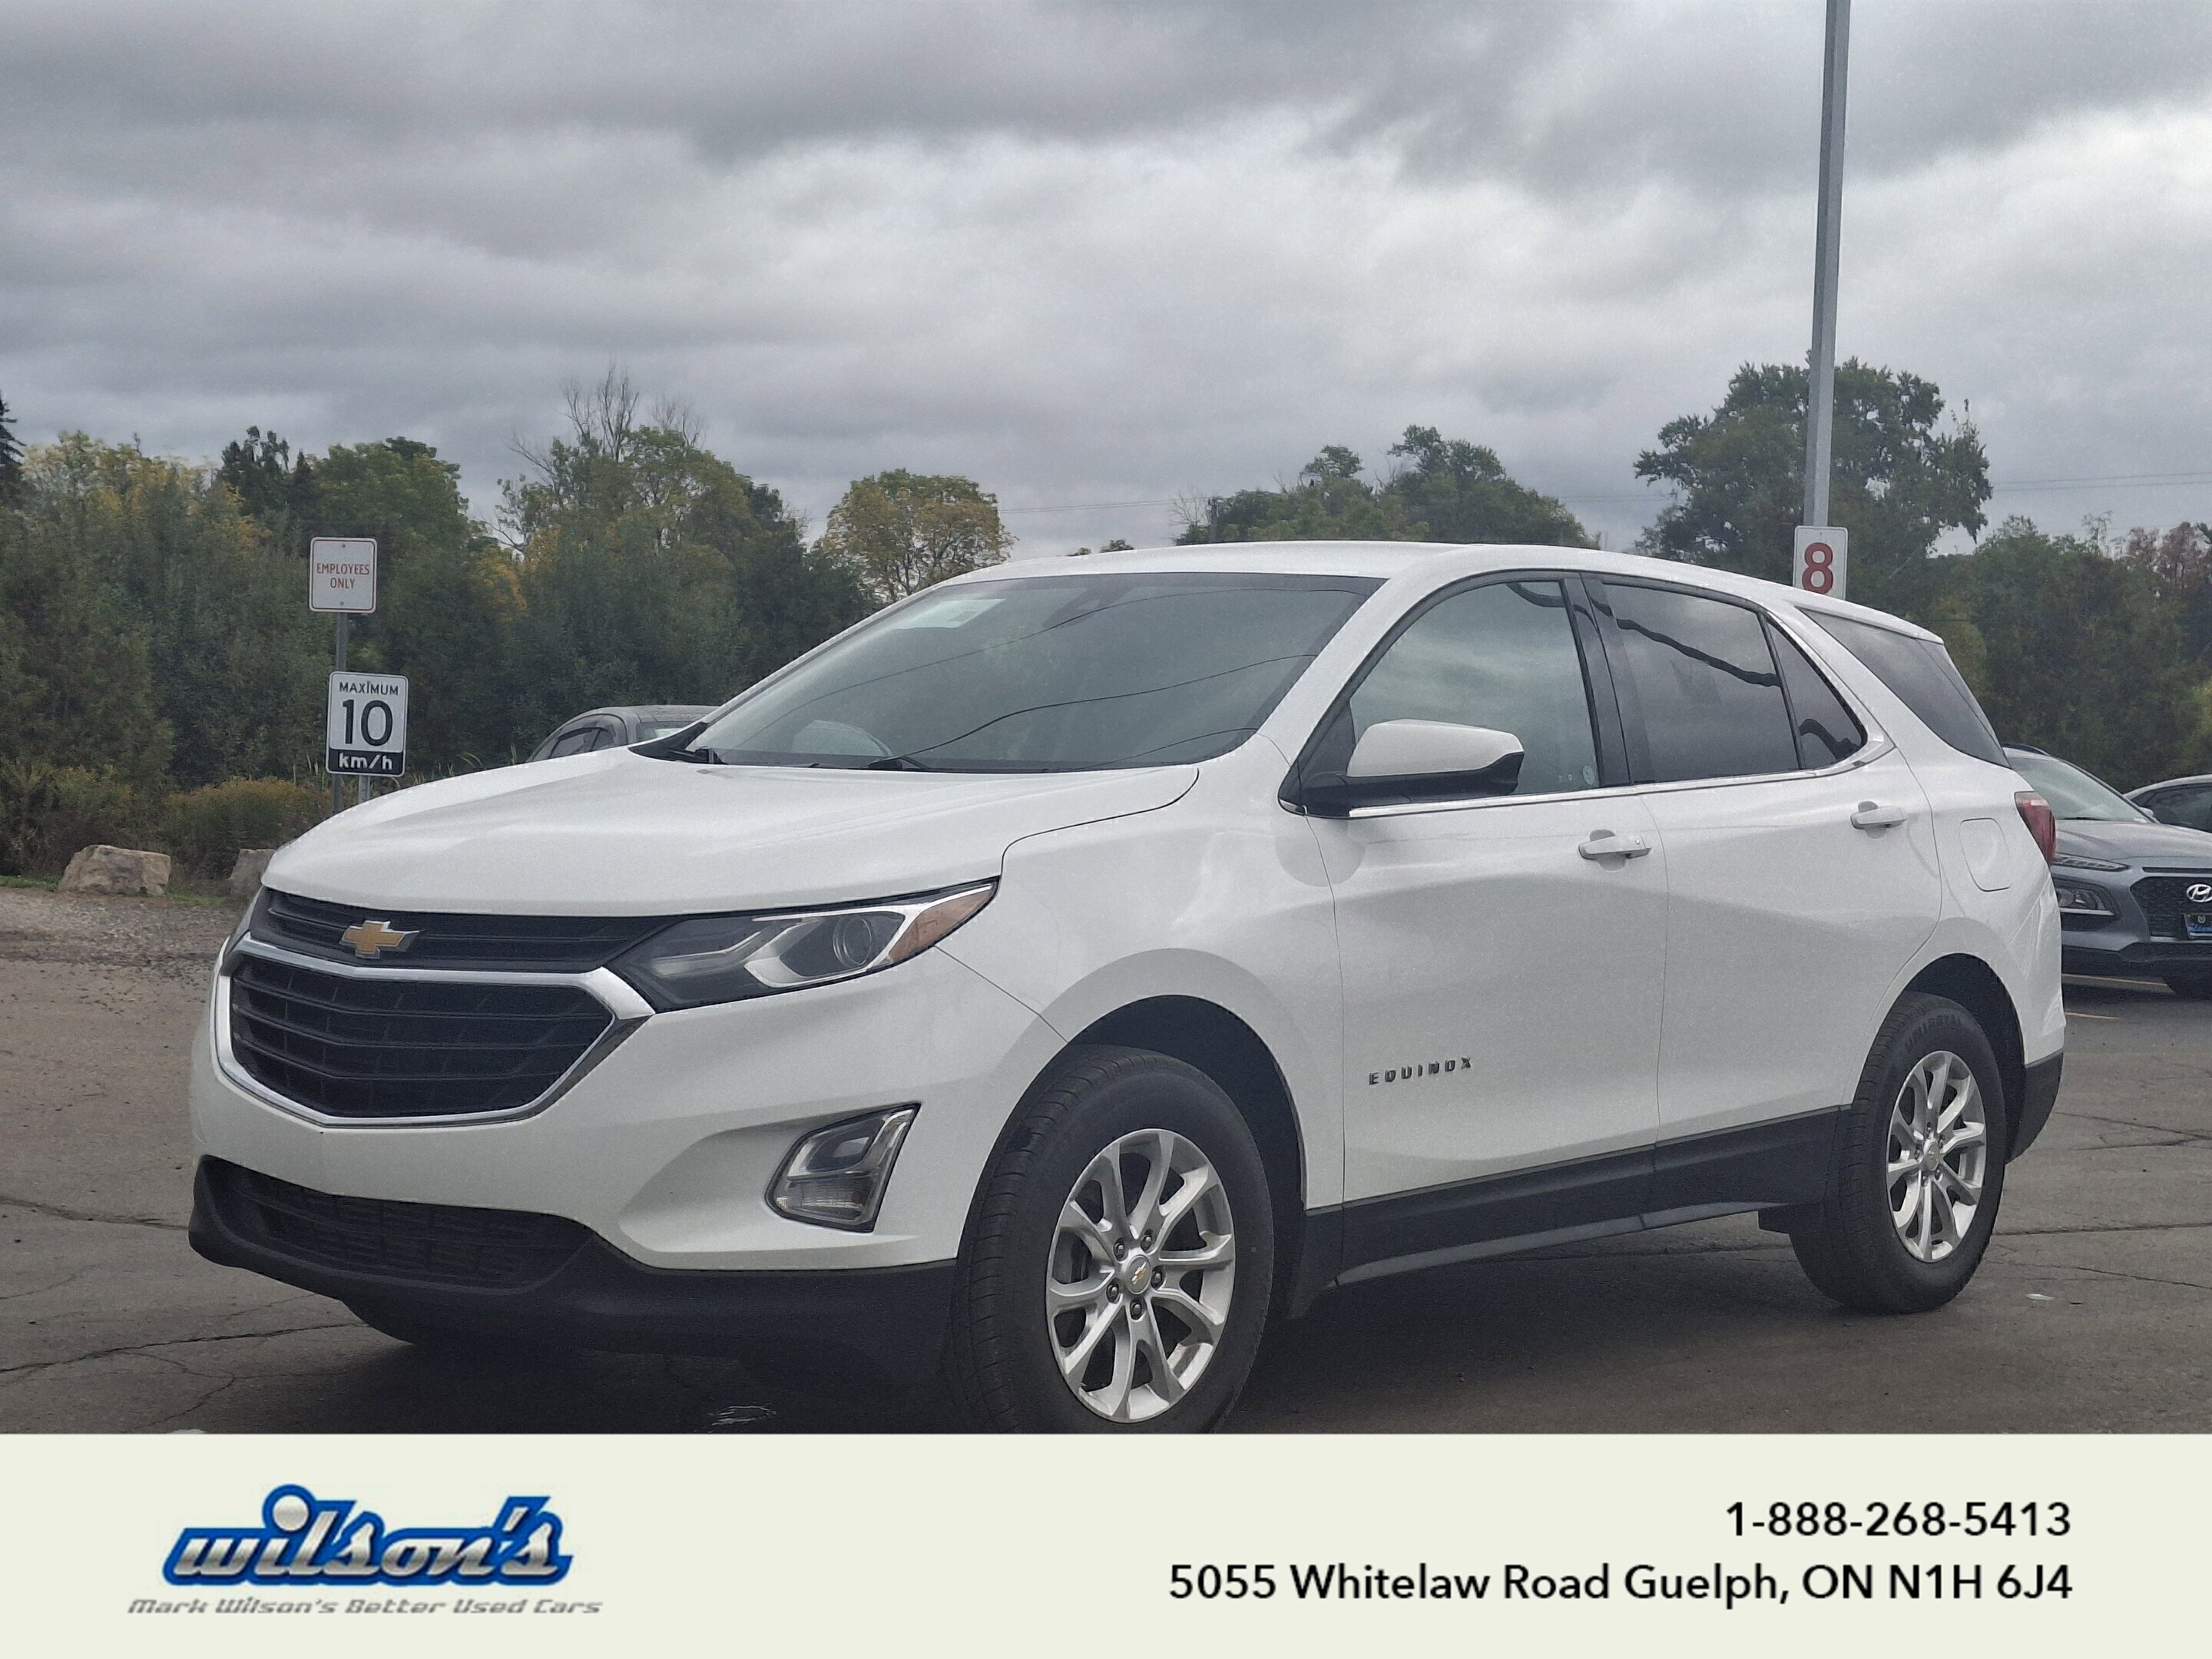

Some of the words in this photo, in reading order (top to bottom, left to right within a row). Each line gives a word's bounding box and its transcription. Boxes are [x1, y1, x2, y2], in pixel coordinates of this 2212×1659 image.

[316, 562, 370, 575] EMPLOYEES
[1802, 542, 1834, 594] 8
[330, 577, 355, 589] ONLY
[339, 681, 399, 696] MAXIMUM
[343, 699, 393, 747] 10
[339, 753, 392, 770] km/h
[1369, 1055, 1472, 1085] EQUINOX
